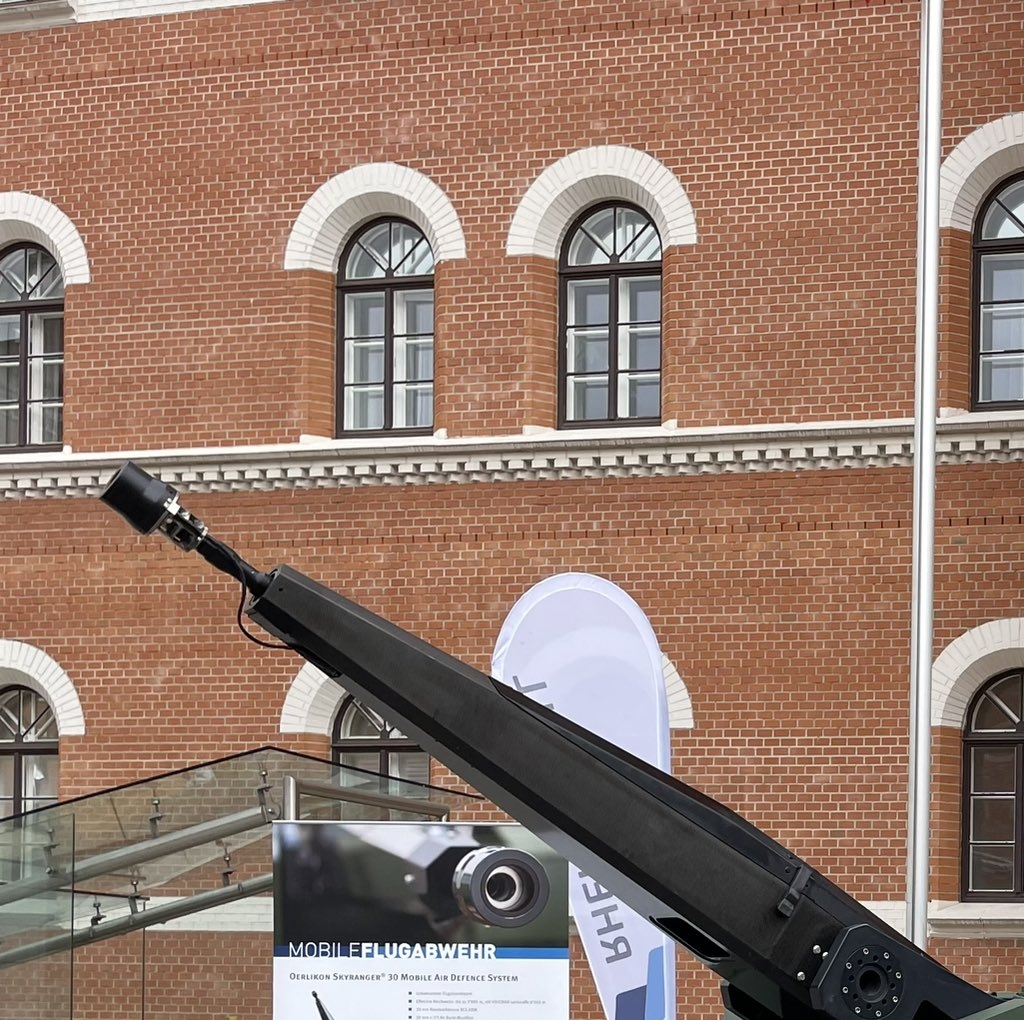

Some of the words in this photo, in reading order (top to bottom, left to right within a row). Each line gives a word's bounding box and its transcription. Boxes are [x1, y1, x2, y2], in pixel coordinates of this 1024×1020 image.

[289, 972, 330, 981] OERLIKON
[388, 973, 399, 982] 30
[400, 973, 432, 982] MOBILE
[434, 973, 449, 982] AIR
[451, 973, 485, 982] DEFENCE
[487, 973, 519, 982] SYSTEM
